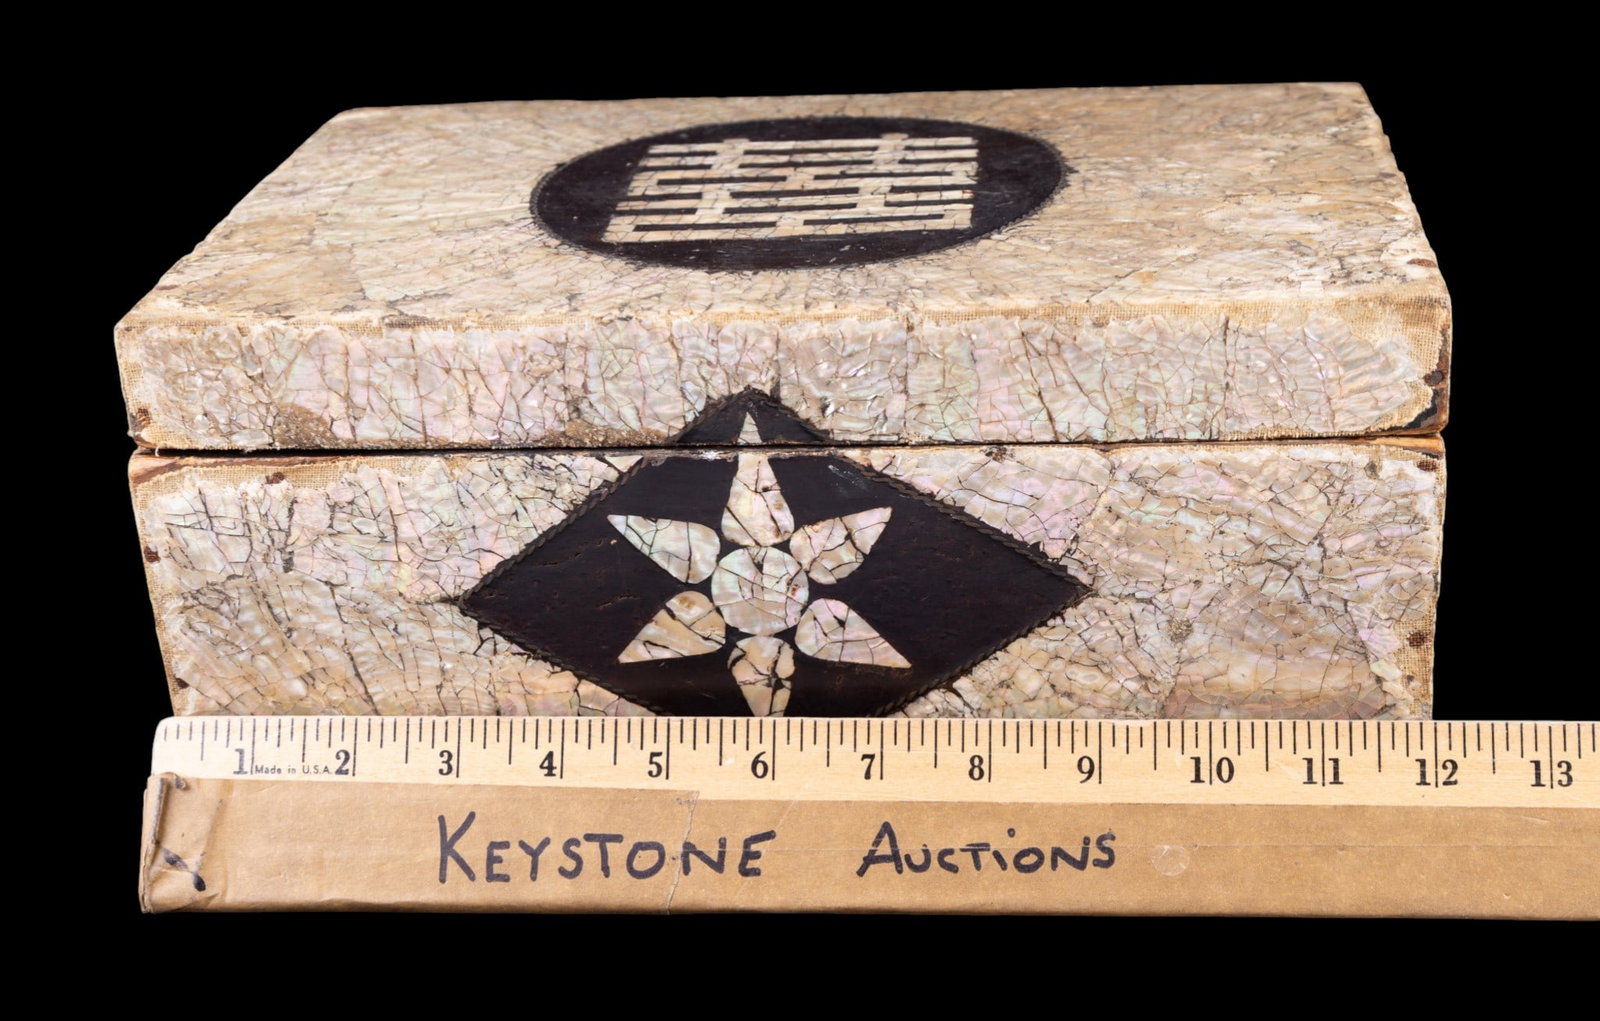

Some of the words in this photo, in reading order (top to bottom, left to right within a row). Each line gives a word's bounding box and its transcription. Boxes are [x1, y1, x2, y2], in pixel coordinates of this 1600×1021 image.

[233, 748, 248, 775] 1
[335, 749, 350, 776] 2
[438, 750, 453, 776] 3
[539, 750, 557, 777] 4
[647, 751, 663, 778] 5
[750, 751, 769, 779] 6
[860, 753, 876, 780] 7
[968, 755, 985, 782] 8
[1077, 755, 1095, 784] 9
[1190, 757, 1235, 784] 10
[1302, 757, 1344, 785] 11
[1415, 758, 1459, 786] 12
[1529, 759, 1574, 787] 13
[255, 765, 282, 775] Made
[288, 765, 296, 774] in
[437, 811, 777, 884] KEYSTONE
